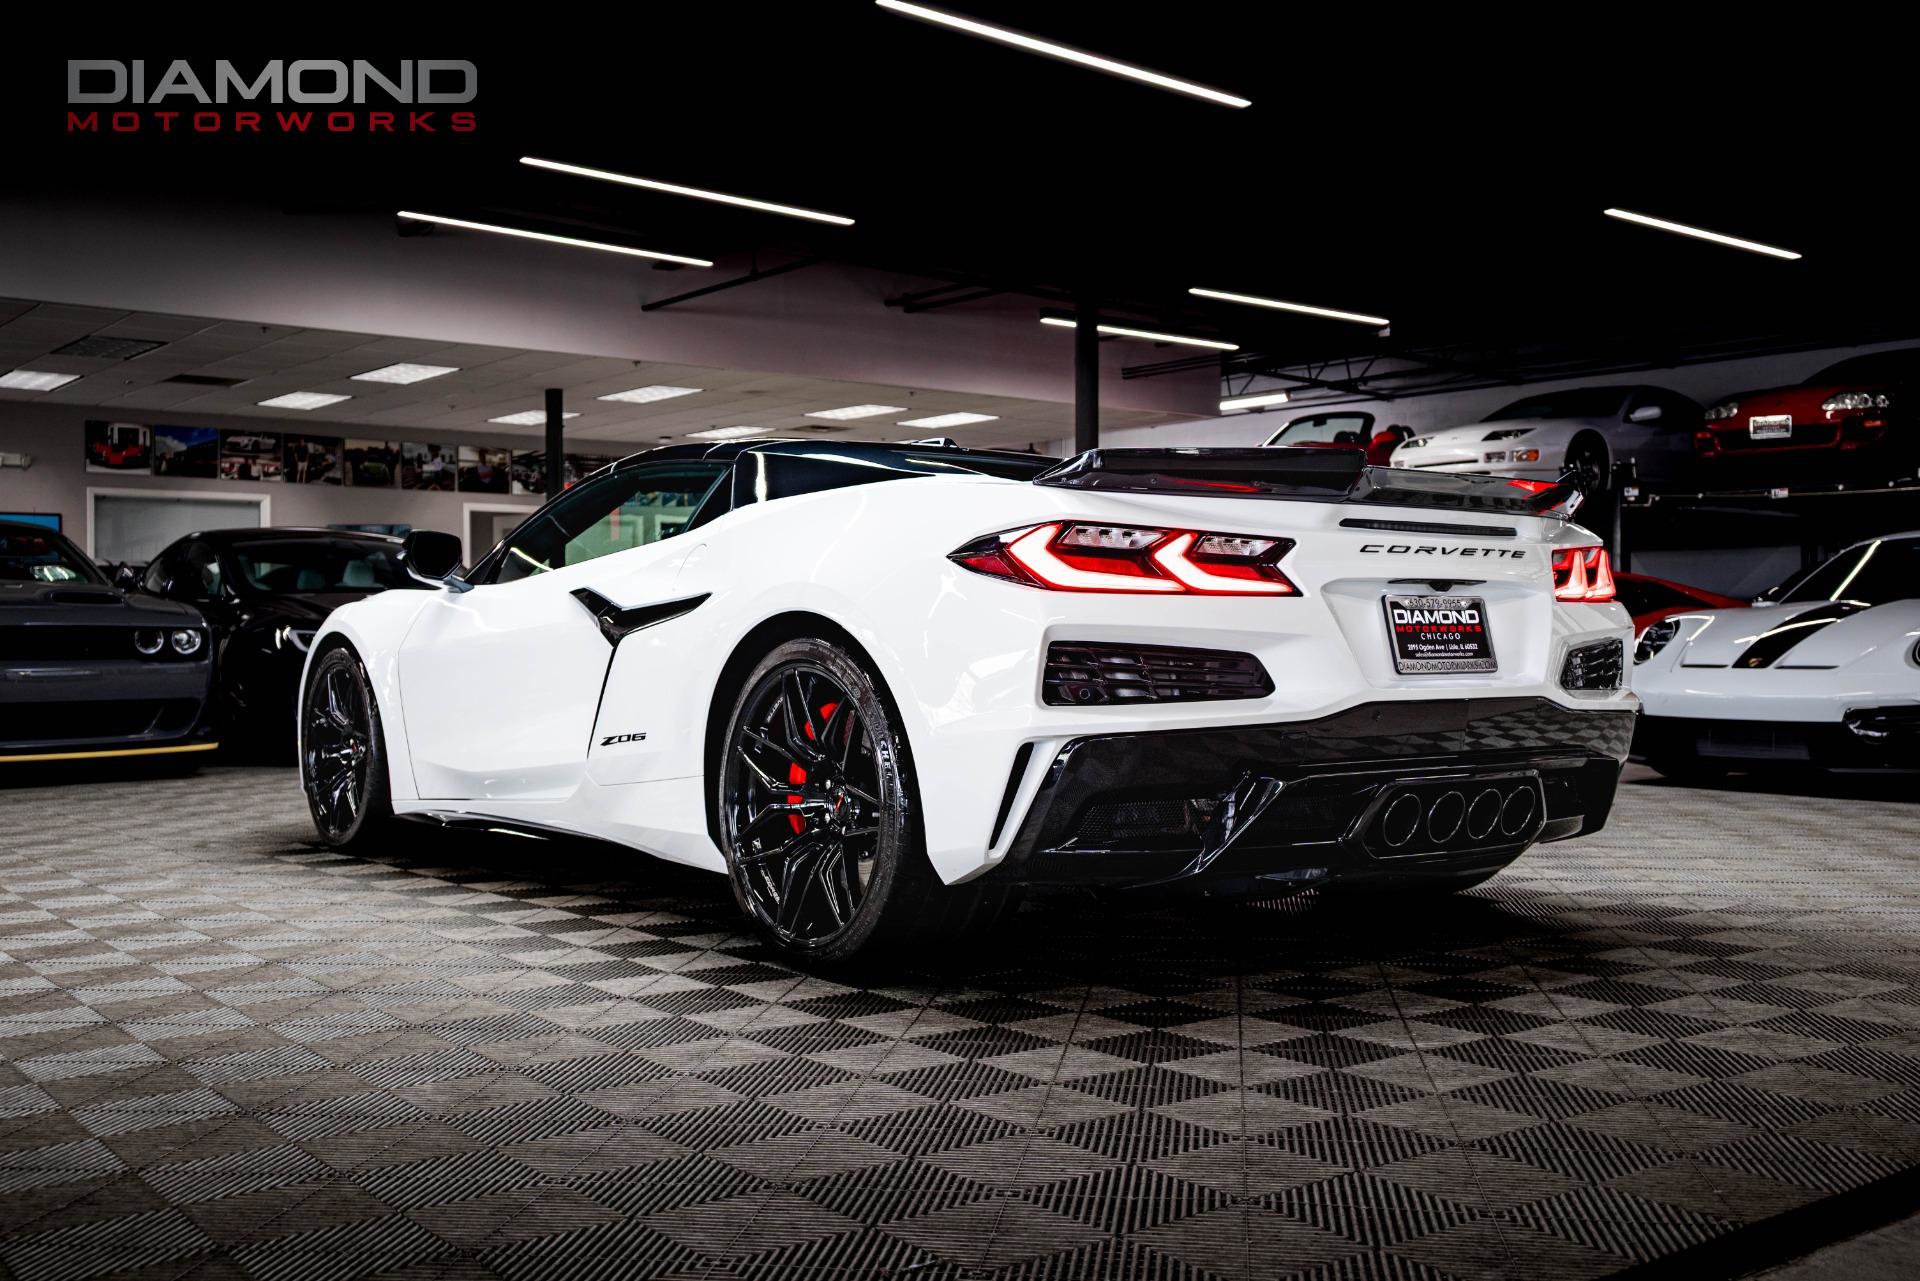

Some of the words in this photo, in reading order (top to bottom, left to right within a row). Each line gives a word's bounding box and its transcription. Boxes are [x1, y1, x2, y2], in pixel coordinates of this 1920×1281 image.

[1359, 544, 1526, 559] CORVETTE
[1393, 609, 1480, 624] DIAMOND
[1395, 625, 1482, 633] MOTORWORKS
[1420, 632, 1461, 640] CHICAGO
[1419, 644, 1435, 652] Ogden
[600, 732, 647, 747] Z06
